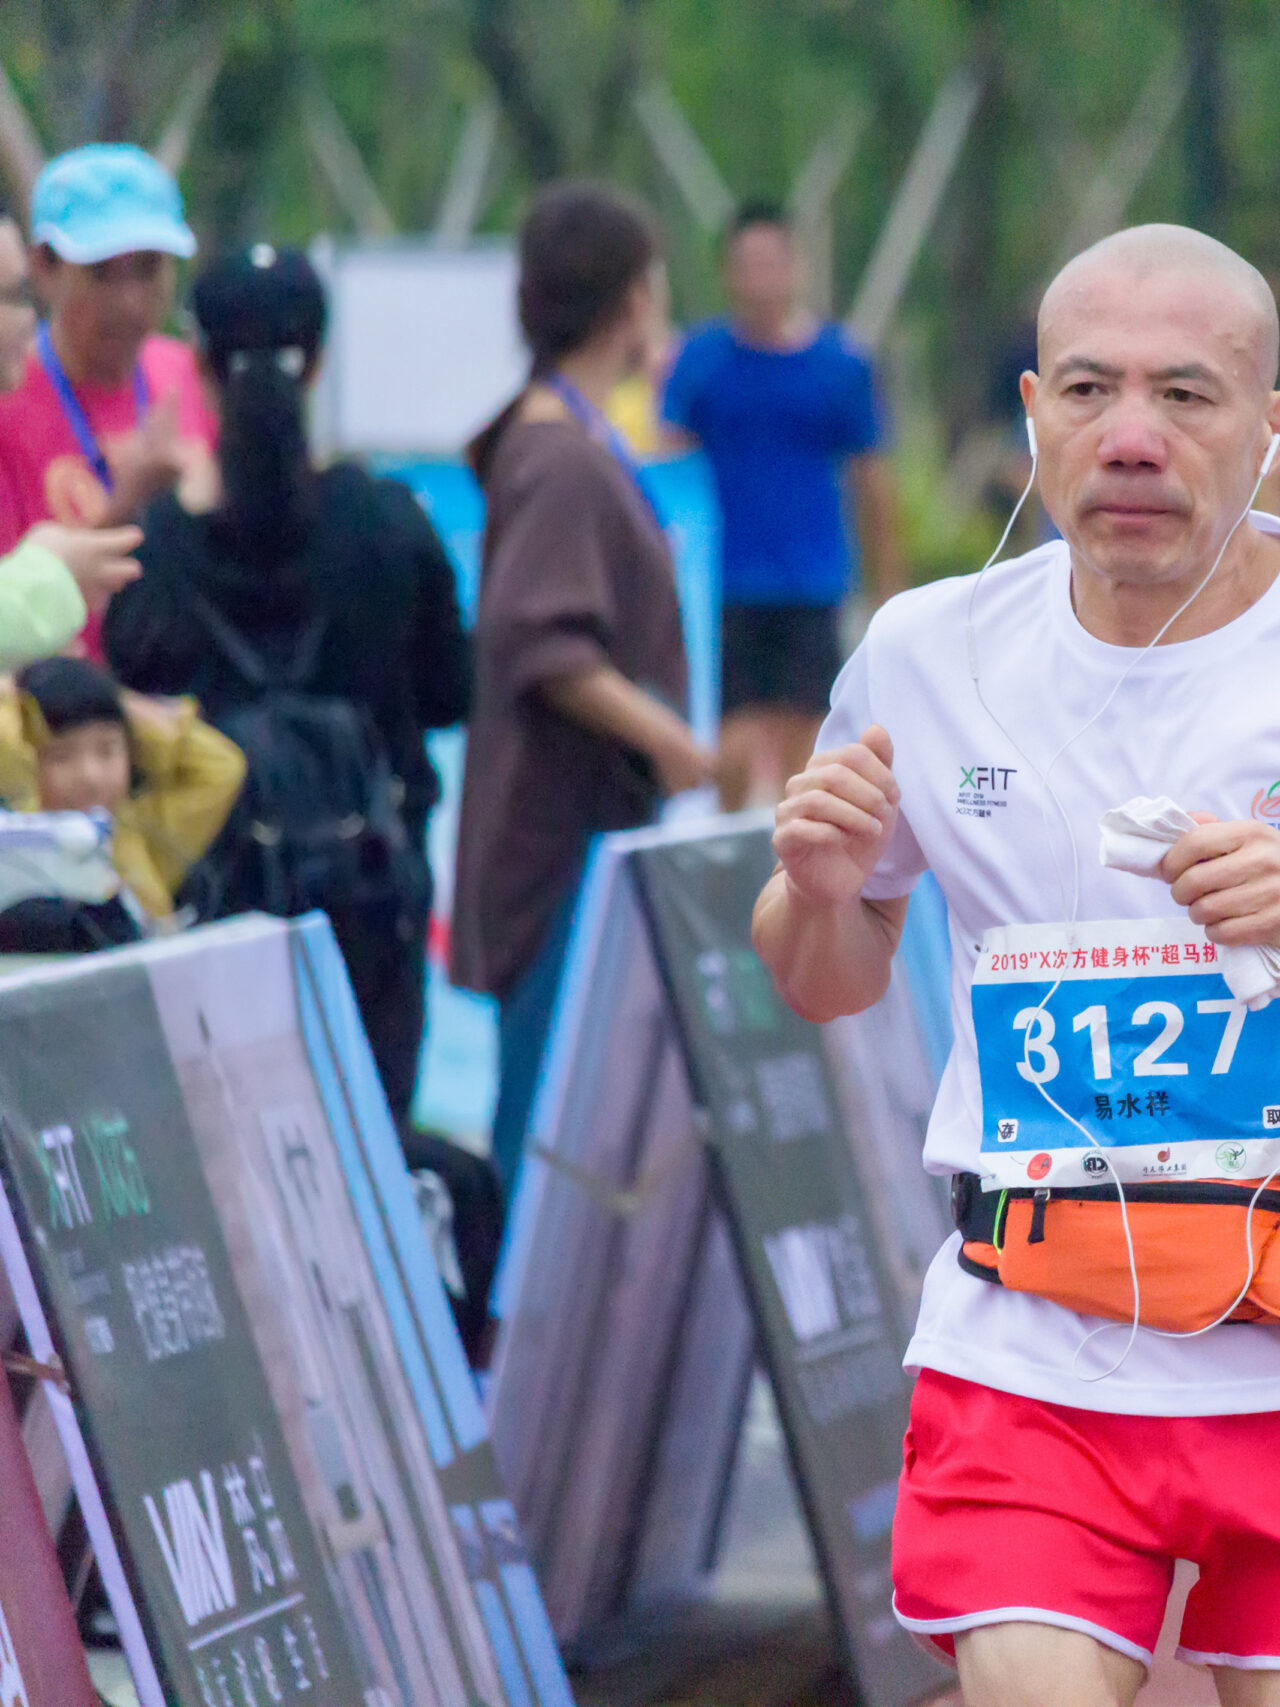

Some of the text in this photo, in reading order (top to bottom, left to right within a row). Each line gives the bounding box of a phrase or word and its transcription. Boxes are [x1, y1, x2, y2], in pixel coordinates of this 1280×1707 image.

[959, 766, 1018, 791] XFIT
[1012, 998, 1248, 1085] 3127
[1094, 1090, 1171, 1121] 易水祥
